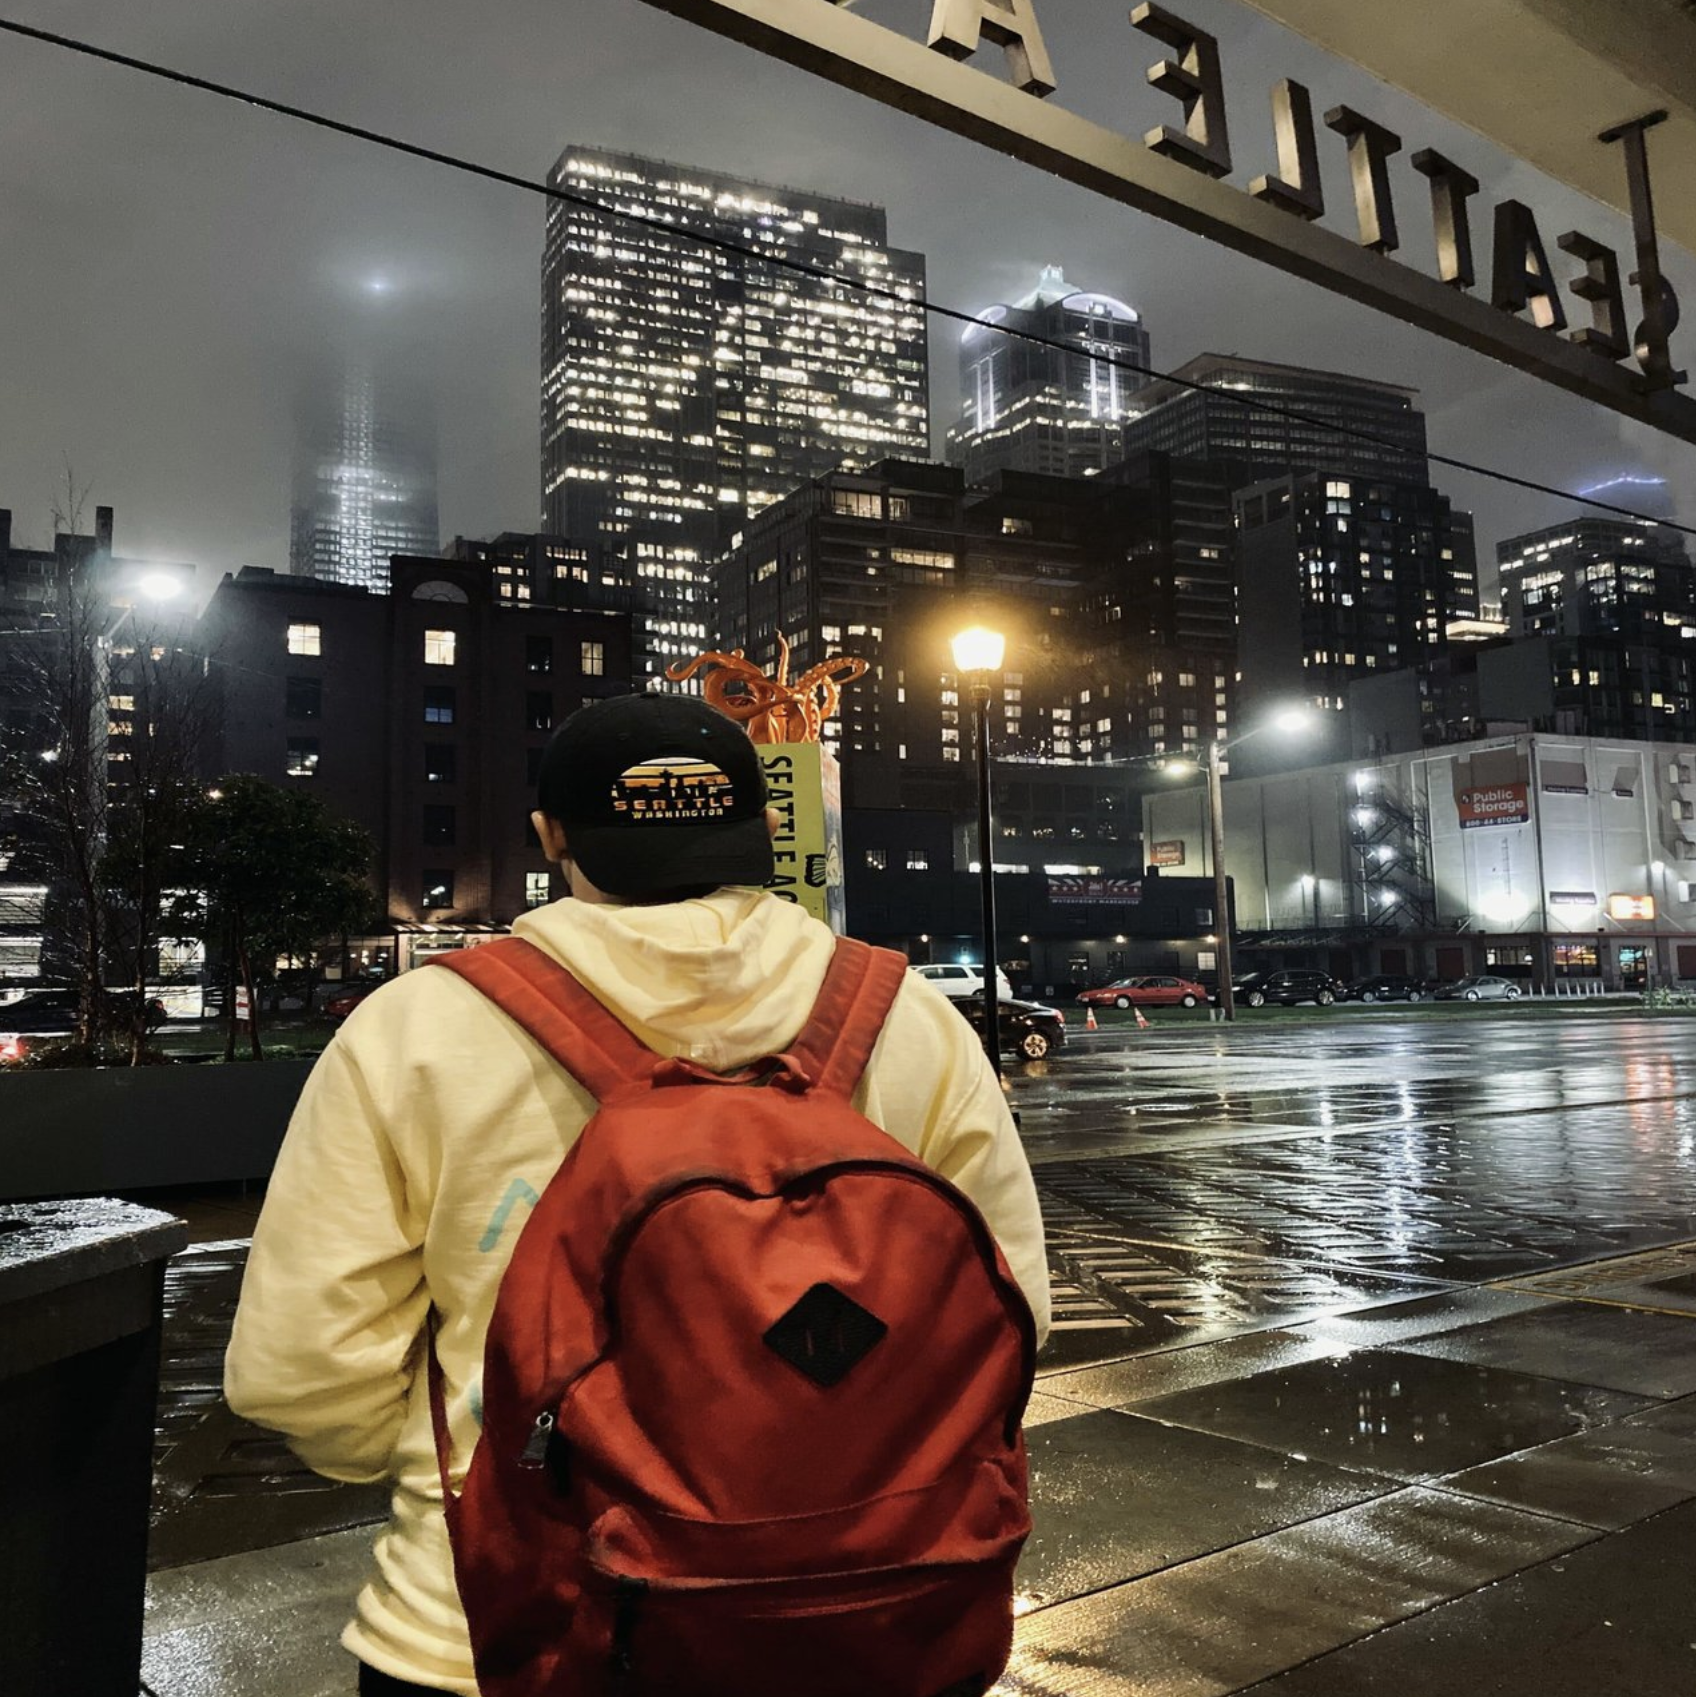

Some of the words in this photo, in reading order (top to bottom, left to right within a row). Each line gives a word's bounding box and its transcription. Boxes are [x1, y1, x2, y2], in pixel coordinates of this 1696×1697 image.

[1472, 789, 1514, 803] Public
[613, 796, 733, 811] SEATTLE
[1473, 800, 1524, 814] Storage
[632, 808, 724, 819] WASHINGTON
